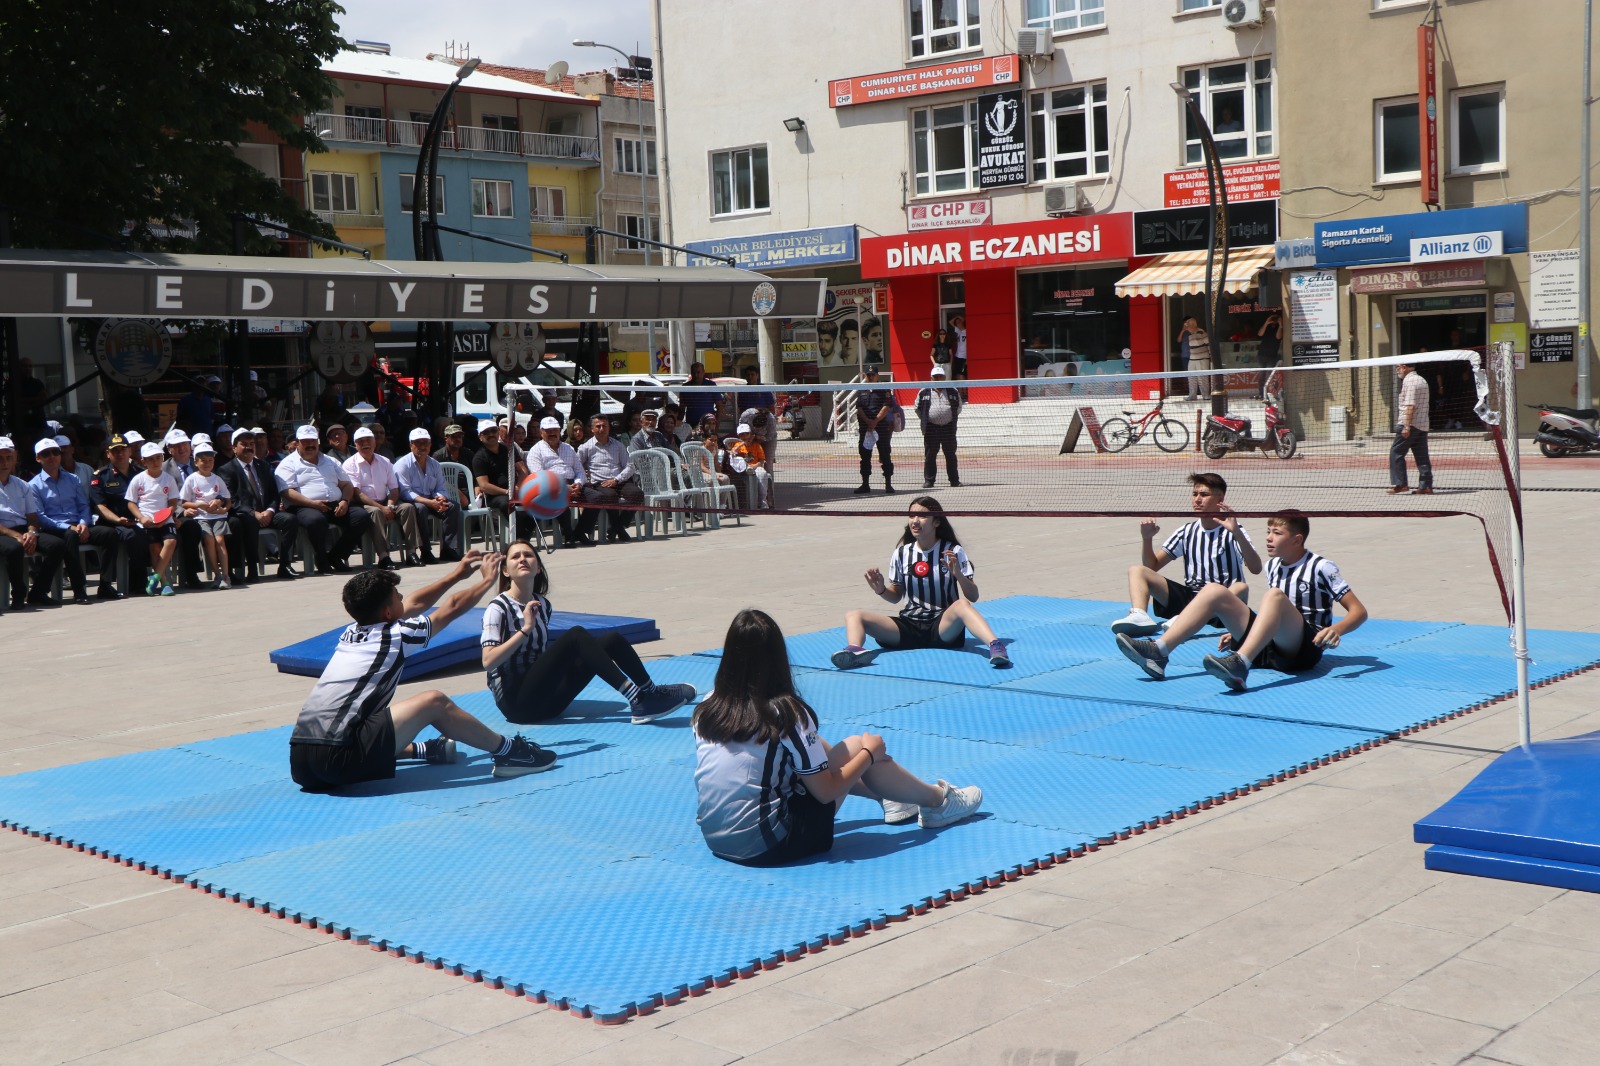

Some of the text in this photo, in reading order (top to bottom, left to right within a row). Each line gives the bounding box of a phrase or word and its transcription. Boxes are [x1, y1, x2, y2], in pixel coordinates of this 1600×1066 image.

[860, 62, 983, 88] CUMHURİYET HALK PARTİSİ
[995, 72, 1010, 81] CHP
[868, 75, 975, 97] DİNAR İLÇE BAŞKANLIĞI
[981, 151, 1025, 168] AVUKAT
[998, 174, 1007, 182] 219
[931, 202, 965, 217] CHP
[1321, 225, 1384, 238] Ramazan Kartal
[711, 232, 824, 254] DİNAR BELEDİYESİ
[886, 224, 1101, 269] DİNAR ECZANESİ
[1322, 234, 1392, 248] Sigorta Acenteliği
[1419, 241, 1470, 256] Allianz
[768, 240, 846, 260] MERKEZİ
[1293, 244, 1316, 258] BİRL
